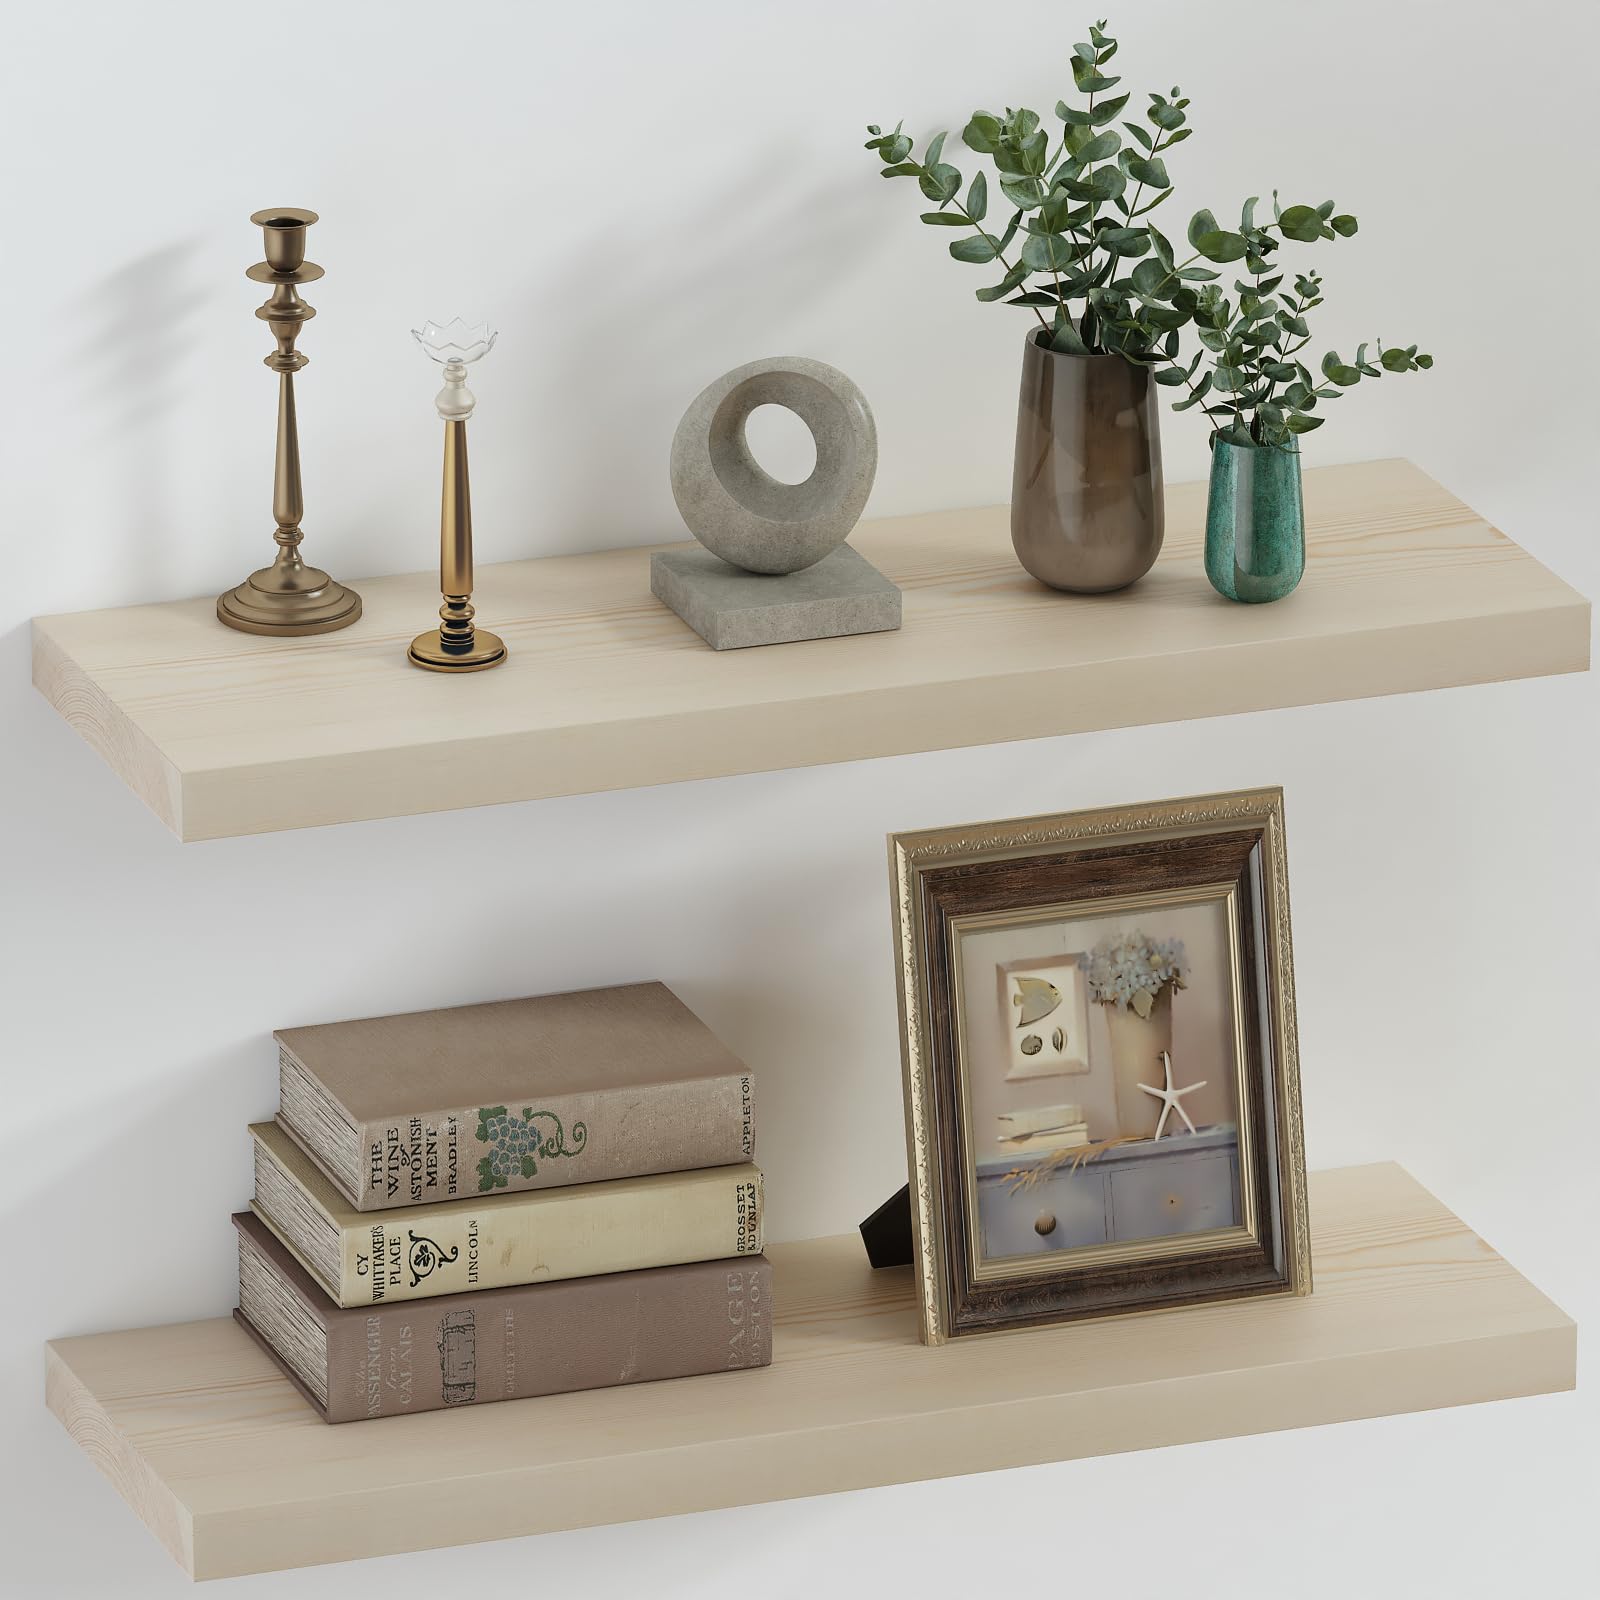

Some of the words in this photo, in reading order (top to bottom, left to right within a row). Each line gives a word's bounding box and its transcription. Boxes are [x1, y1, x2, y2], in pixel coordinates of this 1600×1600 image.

[741, 1077, 751, 1156] APPLETON
[371, 1140, 383, 1190] THE
[387, 1127, 399, 1200] WINE
[400, 1143, 411, 1167] of
[425, 1124, 438, 1188] MENT
[448, 1116, 457, 1195] BRADLEY
[736, 1184, 746, 1253] GROSSET
[356, 1253, 369, 1276] CY
[370, 1224, 385, 1301] WHITTAKER'S
[389, 1236, 401, 1287] PLACE
[468, 1219, 479, 1284] LINCOLN
